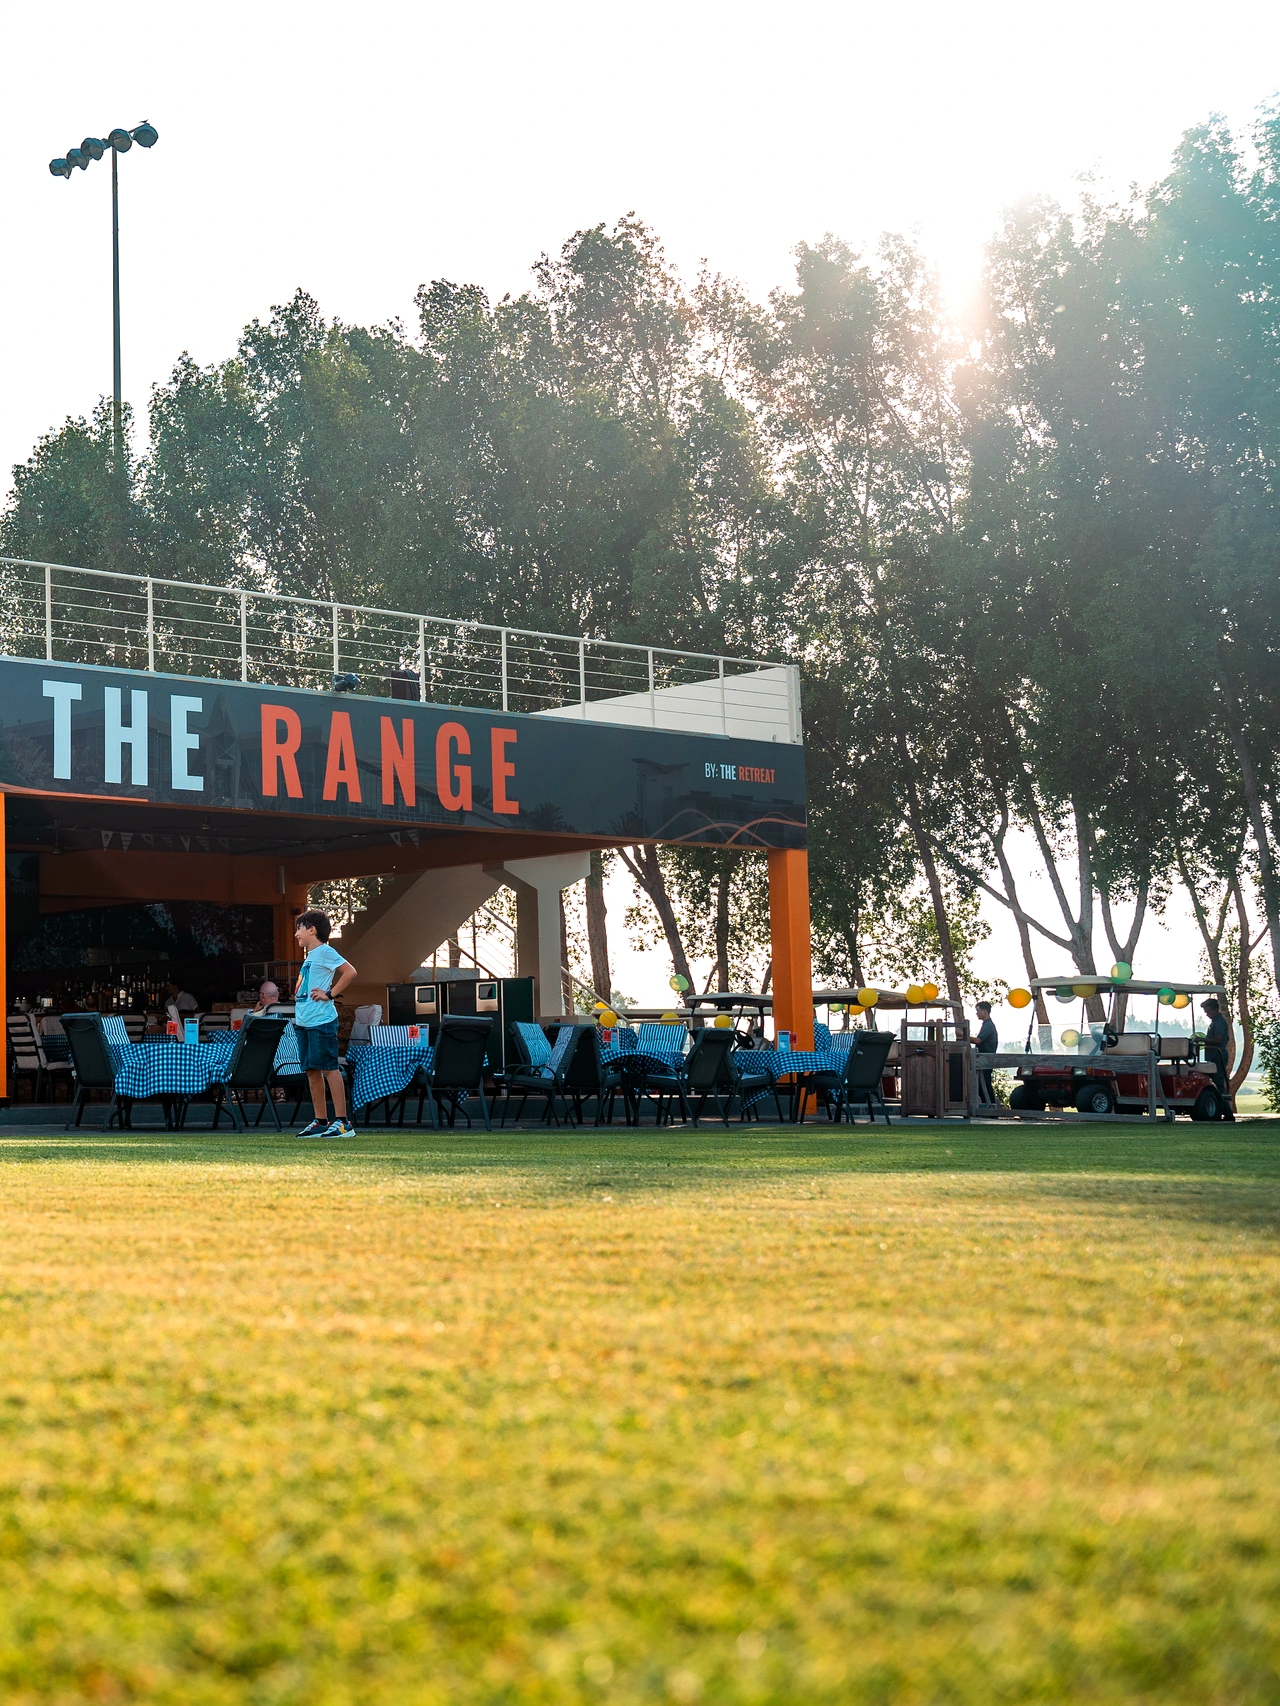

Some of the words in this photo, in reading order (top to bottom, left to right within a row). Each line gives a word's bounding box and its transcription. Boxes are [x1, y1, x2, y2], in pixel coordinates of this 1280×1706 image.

[42, 679, 204, 791] THE
[260, 703, 520, 816] RANGE
[704, 762, 718, 778] BY:
[720, 764, 736, 780] THE
[738, 766, 775, 784] RETREAT
